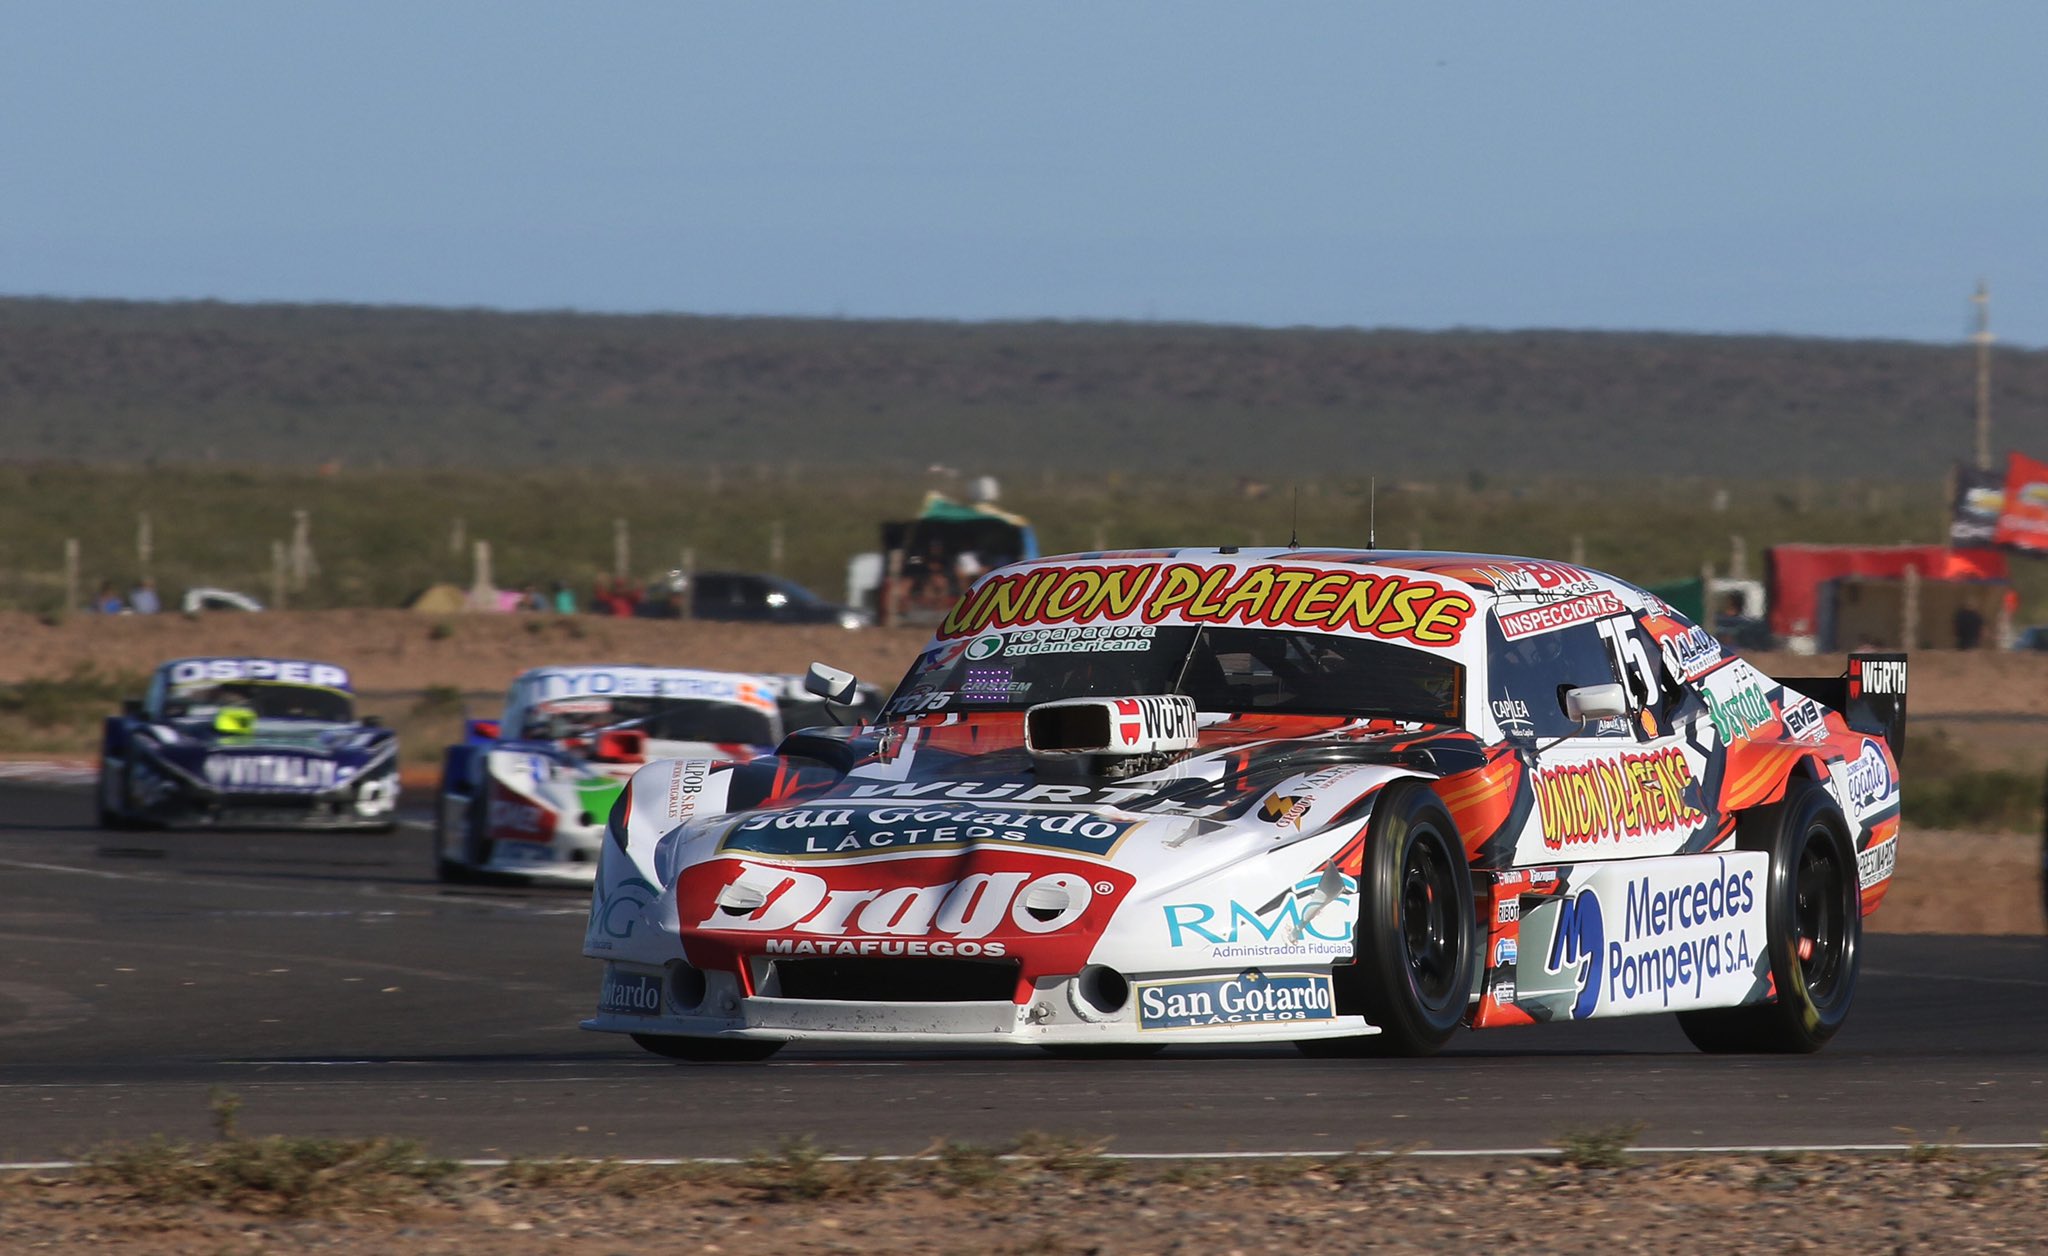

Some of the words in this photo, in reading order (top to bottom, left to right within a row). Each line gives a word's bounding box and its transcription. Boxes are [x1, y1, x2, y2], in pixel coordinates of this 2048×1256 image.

[938, 564, 1161, 640] UNION
[1142, 564, 1475, 646] PLATENSE
[1535, 590, 1559, 604] OIL
[1571, 581, 1599, 593] GAS
[1003, 637, 1152, 657] sudamericana
[1008, 625, 1156, 644] recapadora
[1596, 613, 1659, 710] 75
[1861, 661, 1908, 695] WÜRTH
[961, 681, 1033, 692] CRISTEM
[1138, 697, 1198, 740] WÜRTH
[737, 806, 855, 832] San
[868, 802, 1119, 840] Gotardo
[1532, 759, 1610, 850] UNION
[806, 825, 1027, 853] LÁCTEOS
[697, 860, 1094, 940] Drago
[1498, 905, 1520, 922] RIBOT
[1624, 856, 1754, 943] Mercedes
[1163, 895, 1352, 948] RMG
[765, 938, 1006, 958] MATAFUEGOS
[1212, 943, 1306, 958] Administradora
[1308, 942, 1352, 955] Fiduciaria
[1608, 934, 1721, 1007] Pompeya
[1725, 929, 1755, 974] S.A.
[603, 976, 660, 1010] otardo
[1142, 986, 1208, 1020] San
[1218, 978, 1330, 1015] Gotardo
[1190, 1010, 1306, 1026] LÁCTEOS
